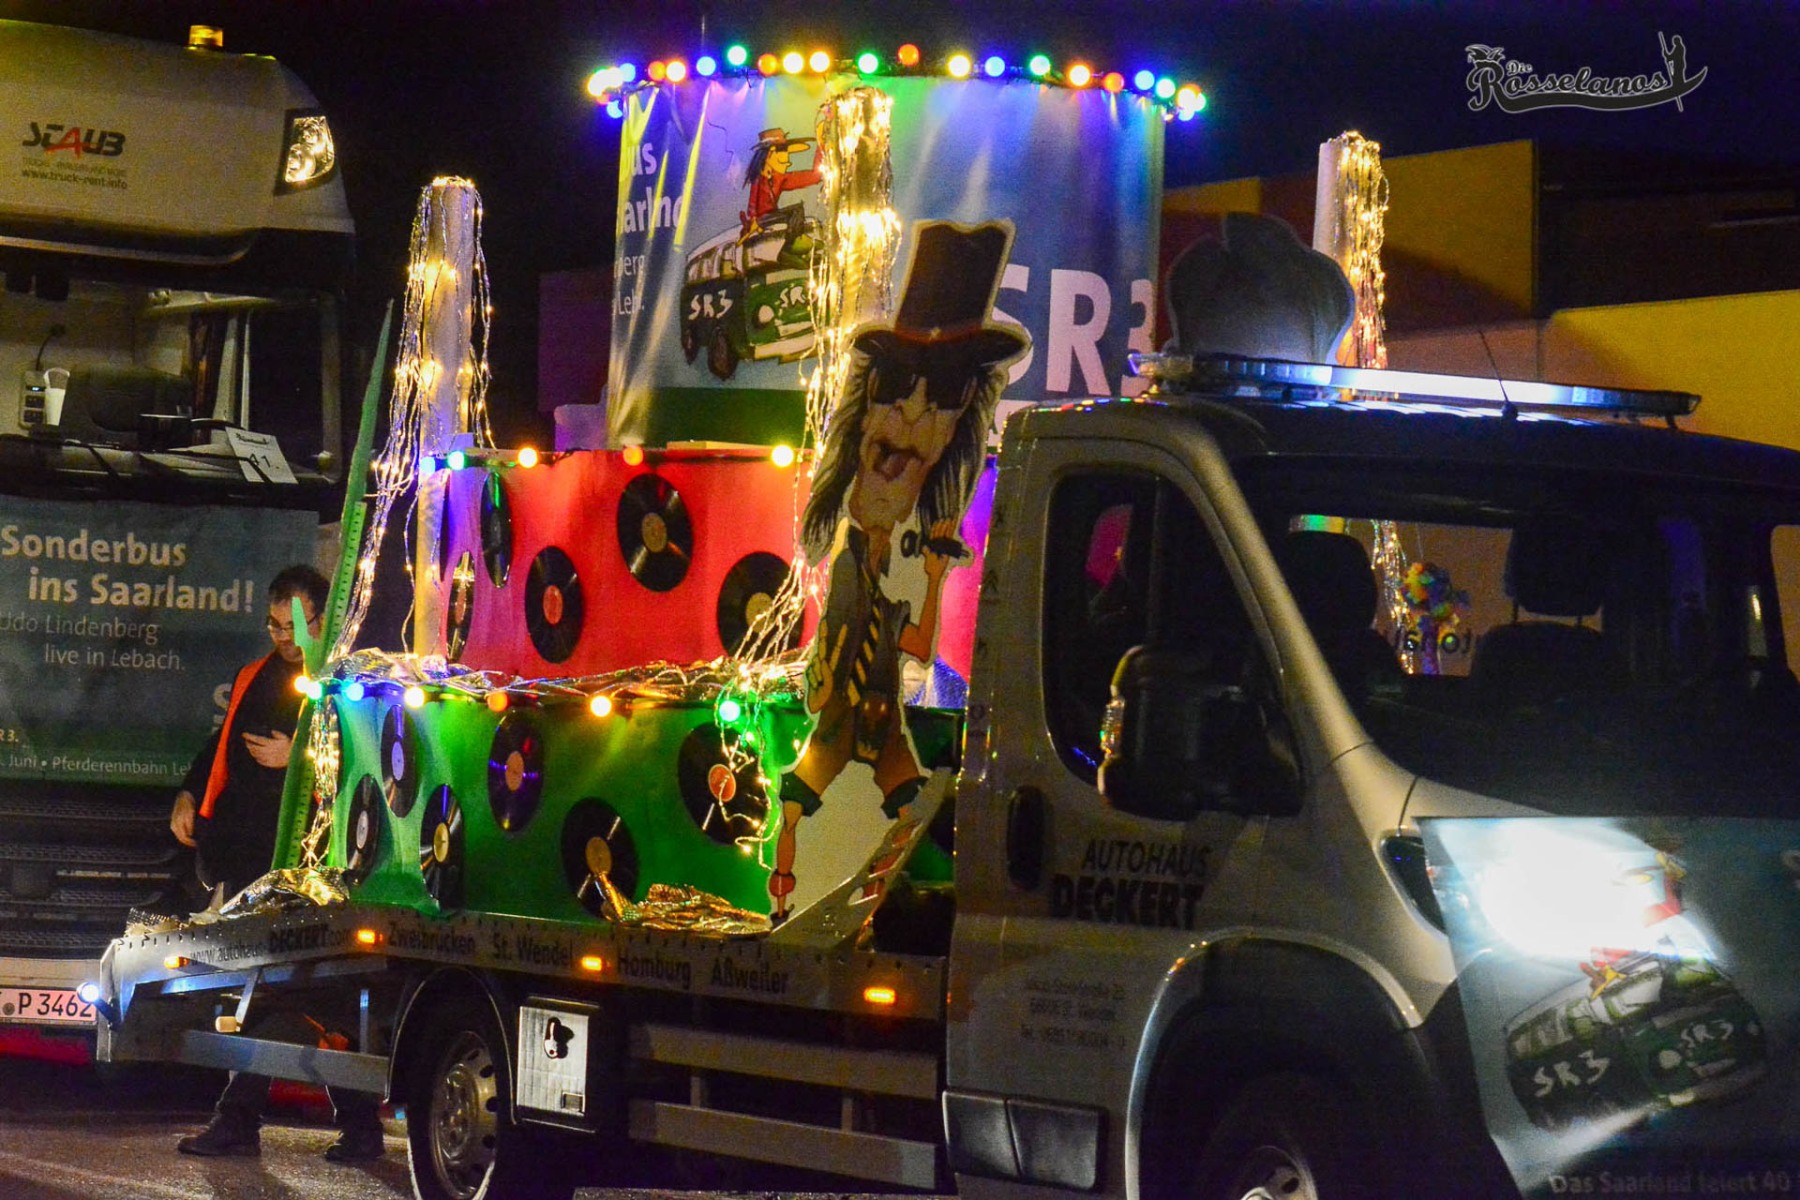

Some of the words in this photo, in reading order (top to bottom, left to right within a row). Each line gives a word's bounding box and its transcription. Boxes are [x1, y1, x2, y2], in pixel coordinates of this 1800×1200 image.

[0, 524, 187, 567] Sonderbus
[28, 566, 78, 604] ins
[90, 572, 256, 614] Saarland!
[46, 614, 160, 647] Lindenberg
[44, 643, 80, 665] live
[86, 646, 106, 667] in
[111, 648, 187, 672] Lebach.
[8, 754, 38, 769] Juni
[52, 756, 168, 776] Pferderennbahn
[1081, 838, 1212, 879] AUTOHAUS
[1051, 873, 1205, 930] DECKERT
[516, 935, 573, 967] Wendel
[617, 948, 692, 990] Homburg
[18, 992, 32, 1015] P
